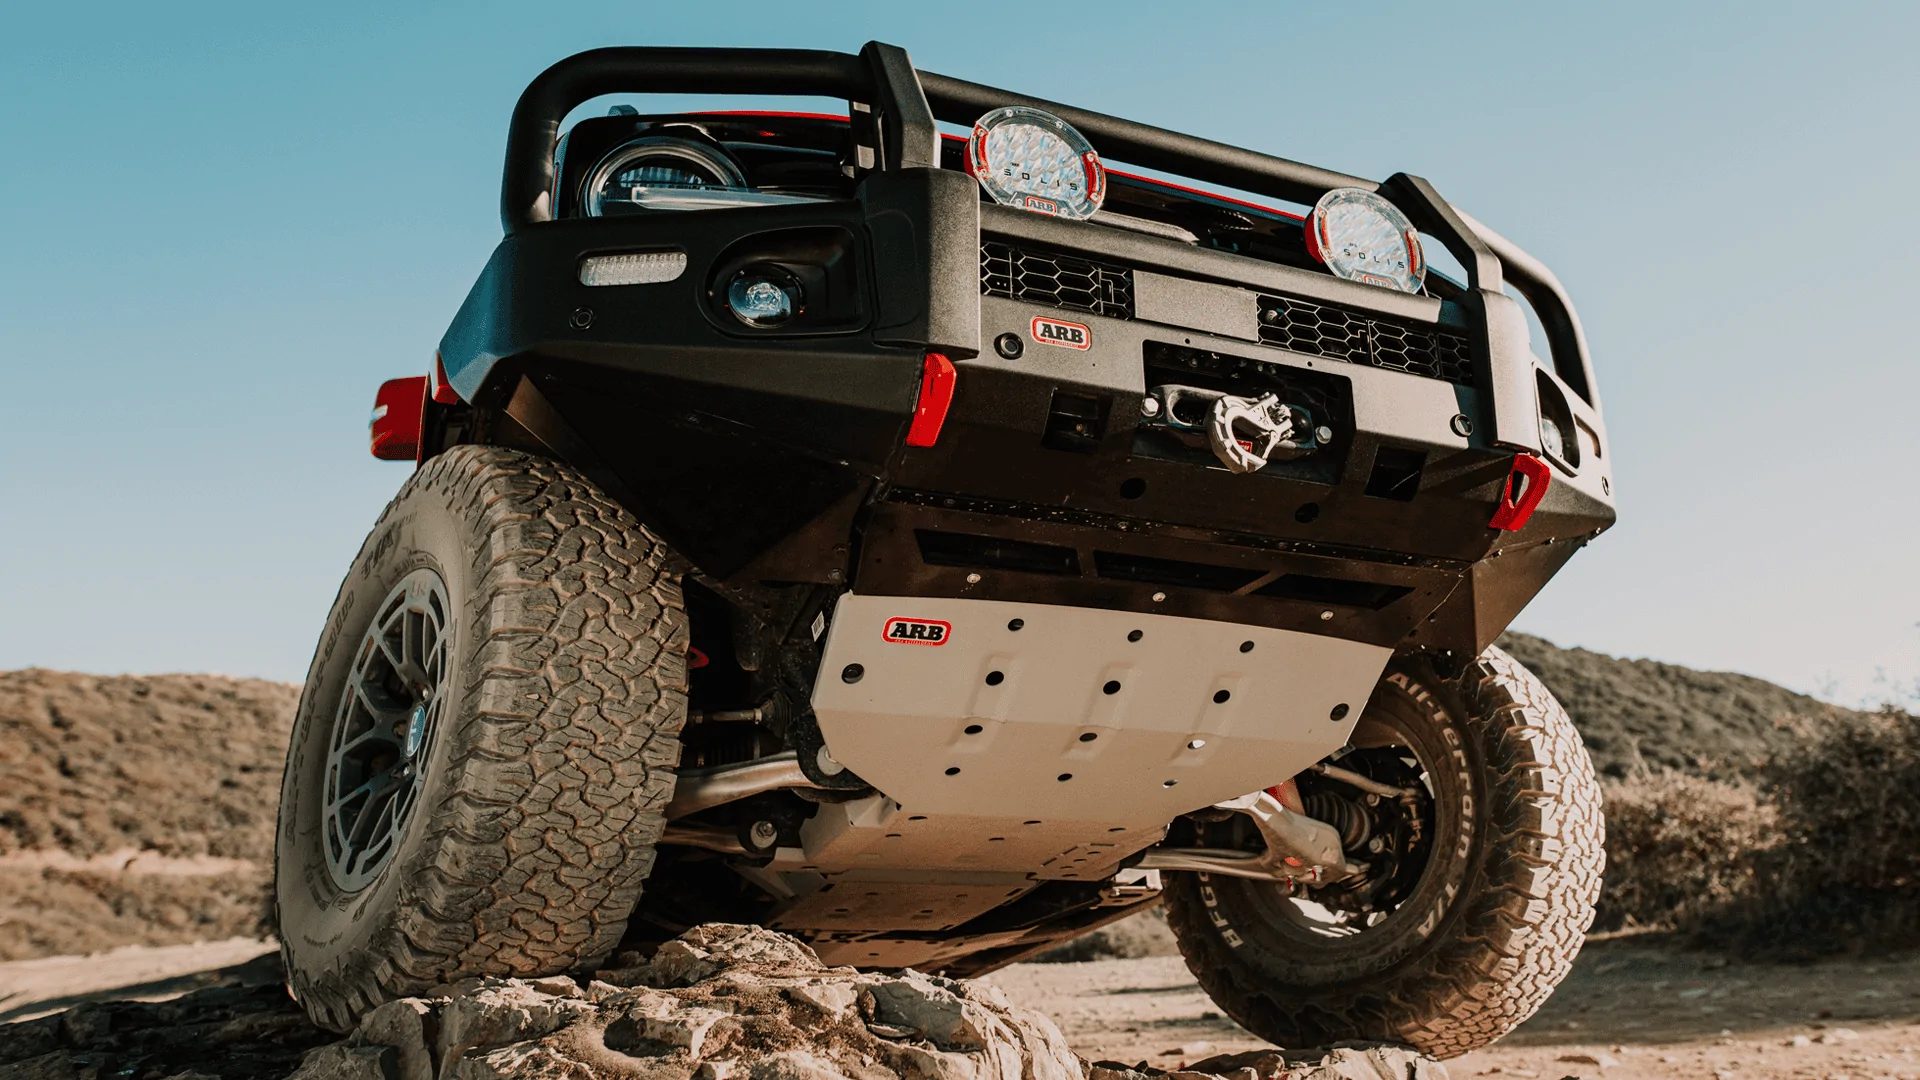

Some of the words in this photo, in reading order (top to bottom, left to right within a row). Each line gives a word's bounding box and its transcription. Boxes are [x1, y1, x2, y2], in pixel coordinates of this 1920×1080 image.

[1003, 168, 1078, 191] SOLIS
[1029, 200, 1054, 212] ARB
[1343, 248, 1405, 269] SOLIS
[1040, 323, 1084, 344] ARB
[889, 622, 944, 641] ARB
